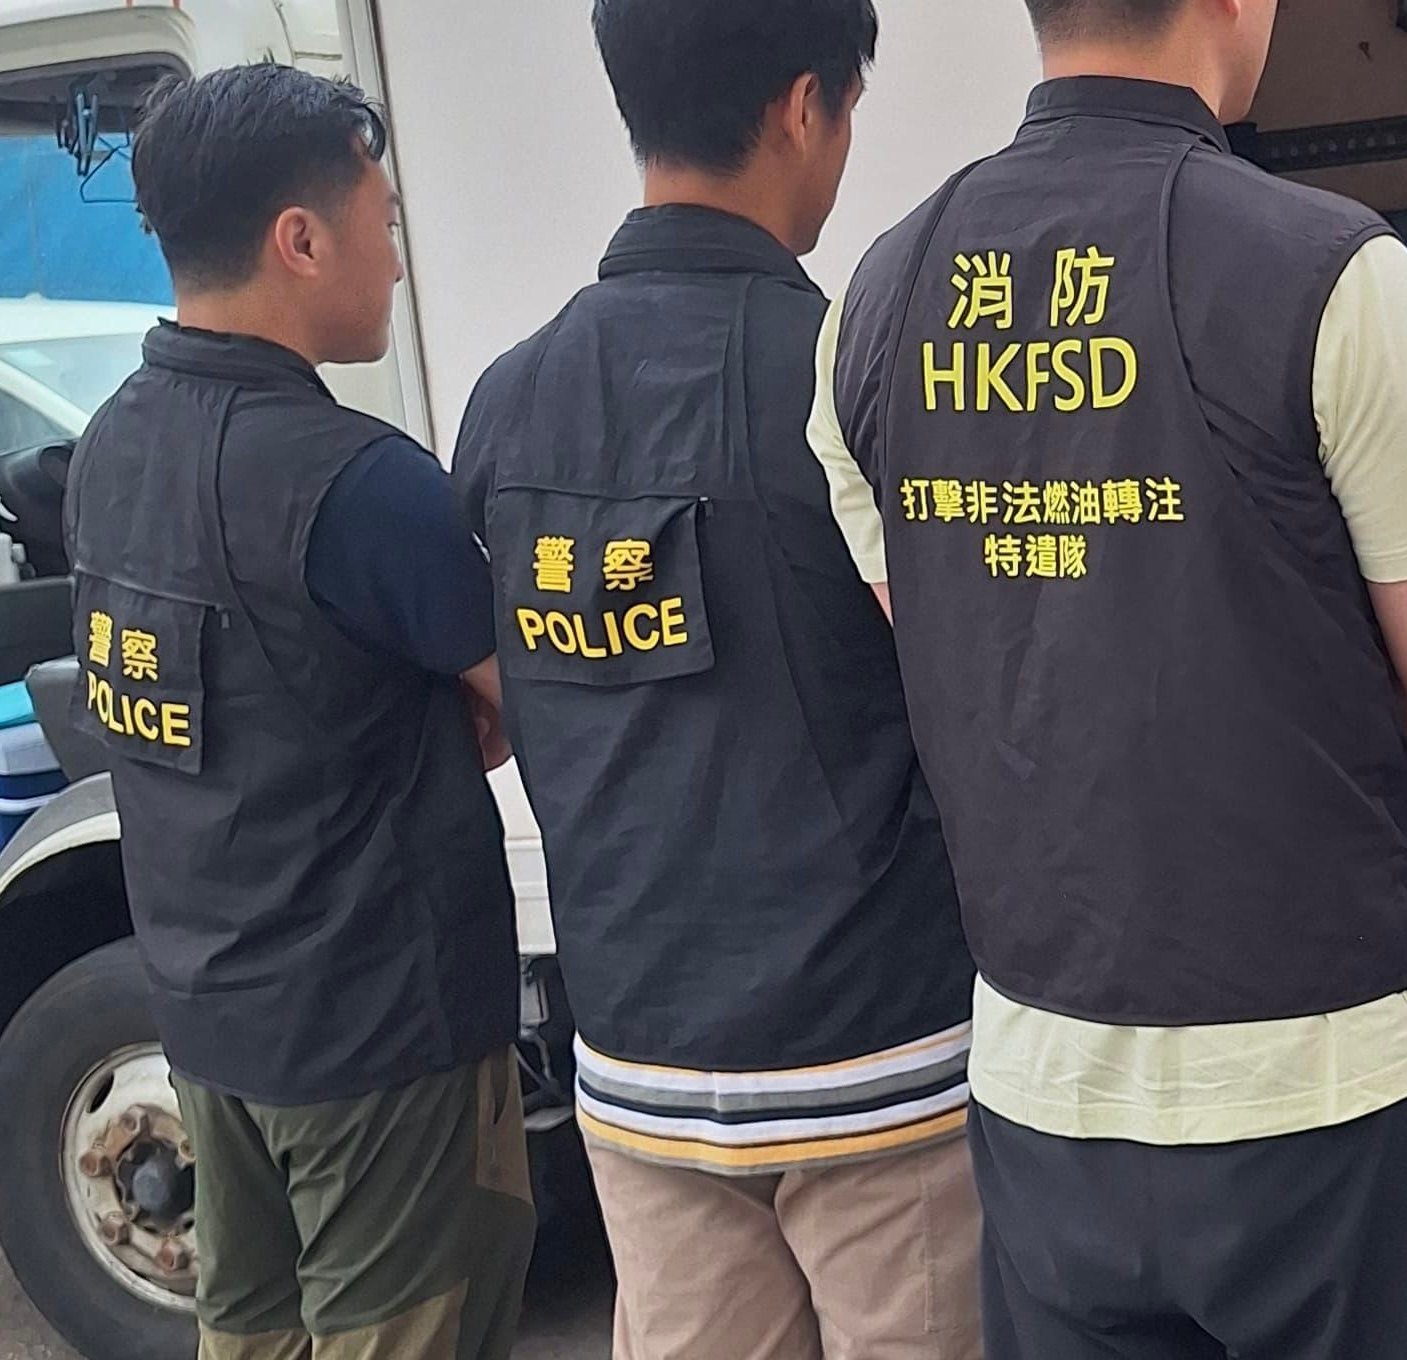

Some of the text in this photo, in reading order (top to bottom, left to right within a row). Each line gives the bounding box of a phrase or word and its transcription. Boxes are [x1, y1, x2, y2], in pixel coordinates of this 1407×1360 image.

[948, 246, 1114, 329] 消防
[922, 337, 1137, 412] HKFSD
[899, 476, 1185, 525] 打擊非法燃油轉注
[533, 535, 653, 593] 警察
[984, 533, 1087, 579] 特遣隊
[88, 610, 159, 681] 警察
[516, 596, 688, 658] POLICE
[87, 670, 191, 747] POLICE
